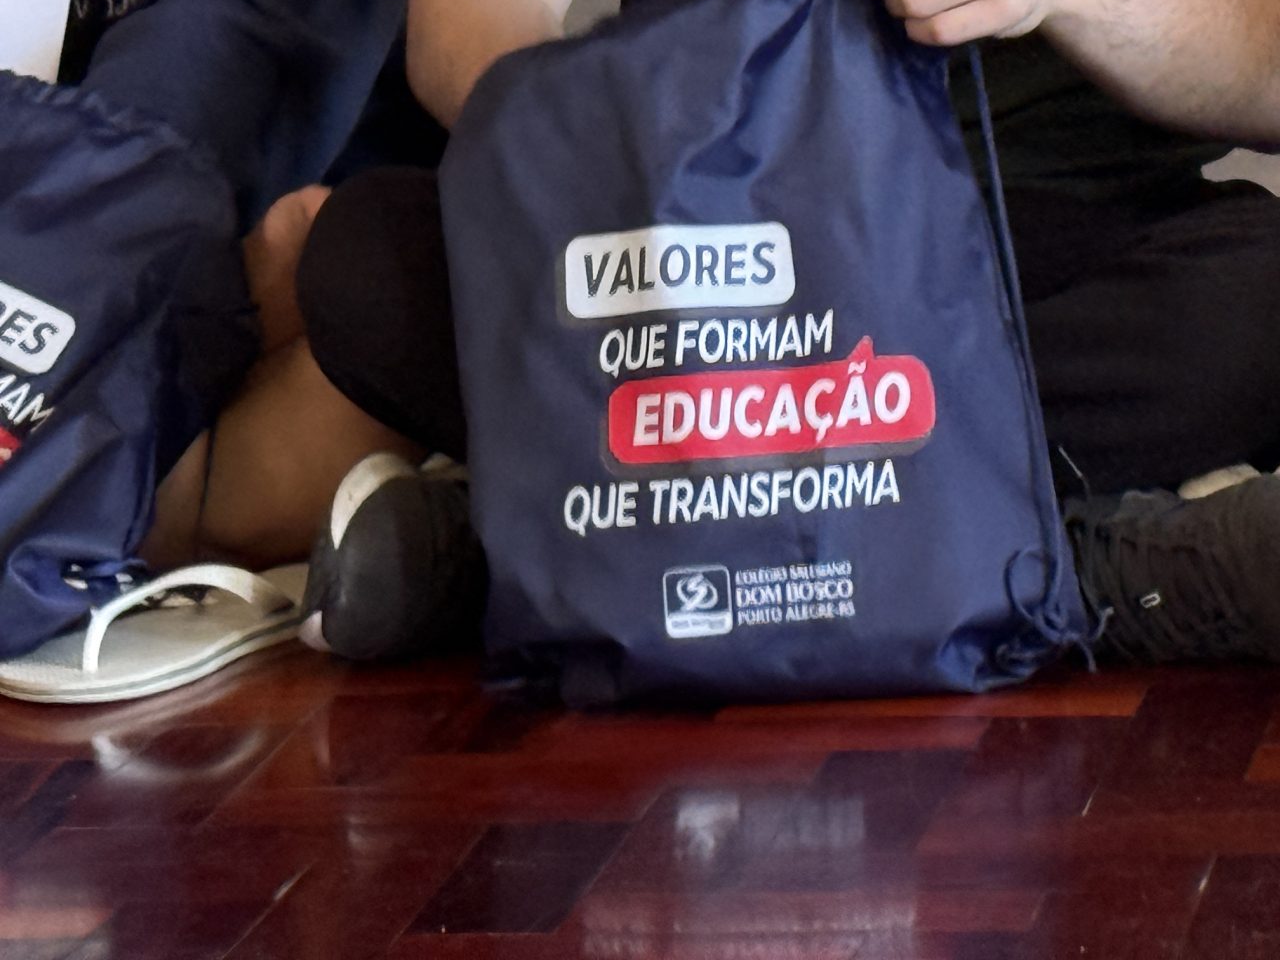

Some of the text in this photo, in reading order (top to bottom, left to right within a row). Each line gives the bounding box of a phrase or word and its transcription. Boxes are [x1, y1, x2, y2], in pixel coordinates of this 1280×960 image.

[584, 241, 777, 298] VALORES
[600, 309, 834, 379] QUE FORMAM
[633, 361, 912, 448] EDUCAÇÃO
[563, 459, 901, 537] QUE TRANSFORMA
